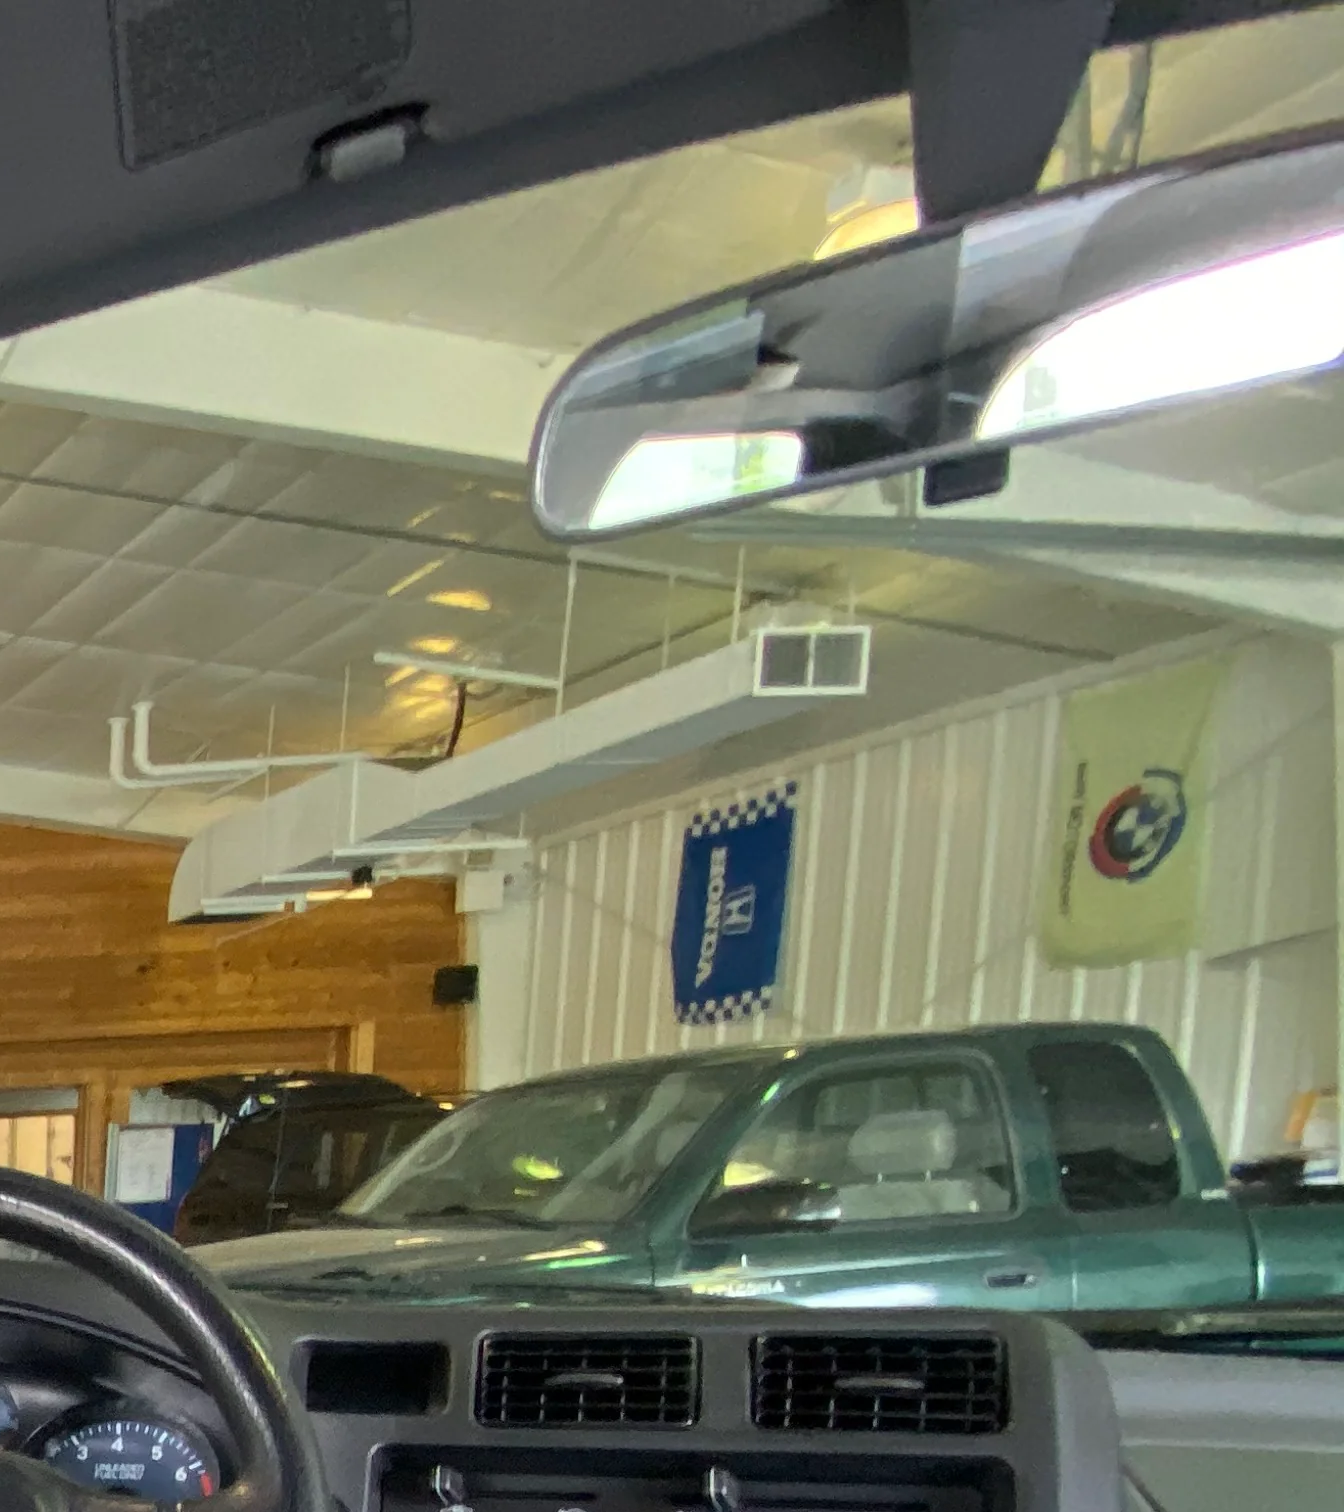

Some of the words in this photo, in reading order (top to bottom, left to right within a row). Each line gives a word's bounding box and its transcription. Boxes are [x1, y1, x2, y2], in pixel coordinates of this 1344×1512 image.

[695, 847, 728, 989] HONDA
[76, 1445, 89, 1461] 3
[111, 1436, 124, 1453] 4
[151, 1445, 163, 1461] 5
[174, 1465, 188, 1482] 6
